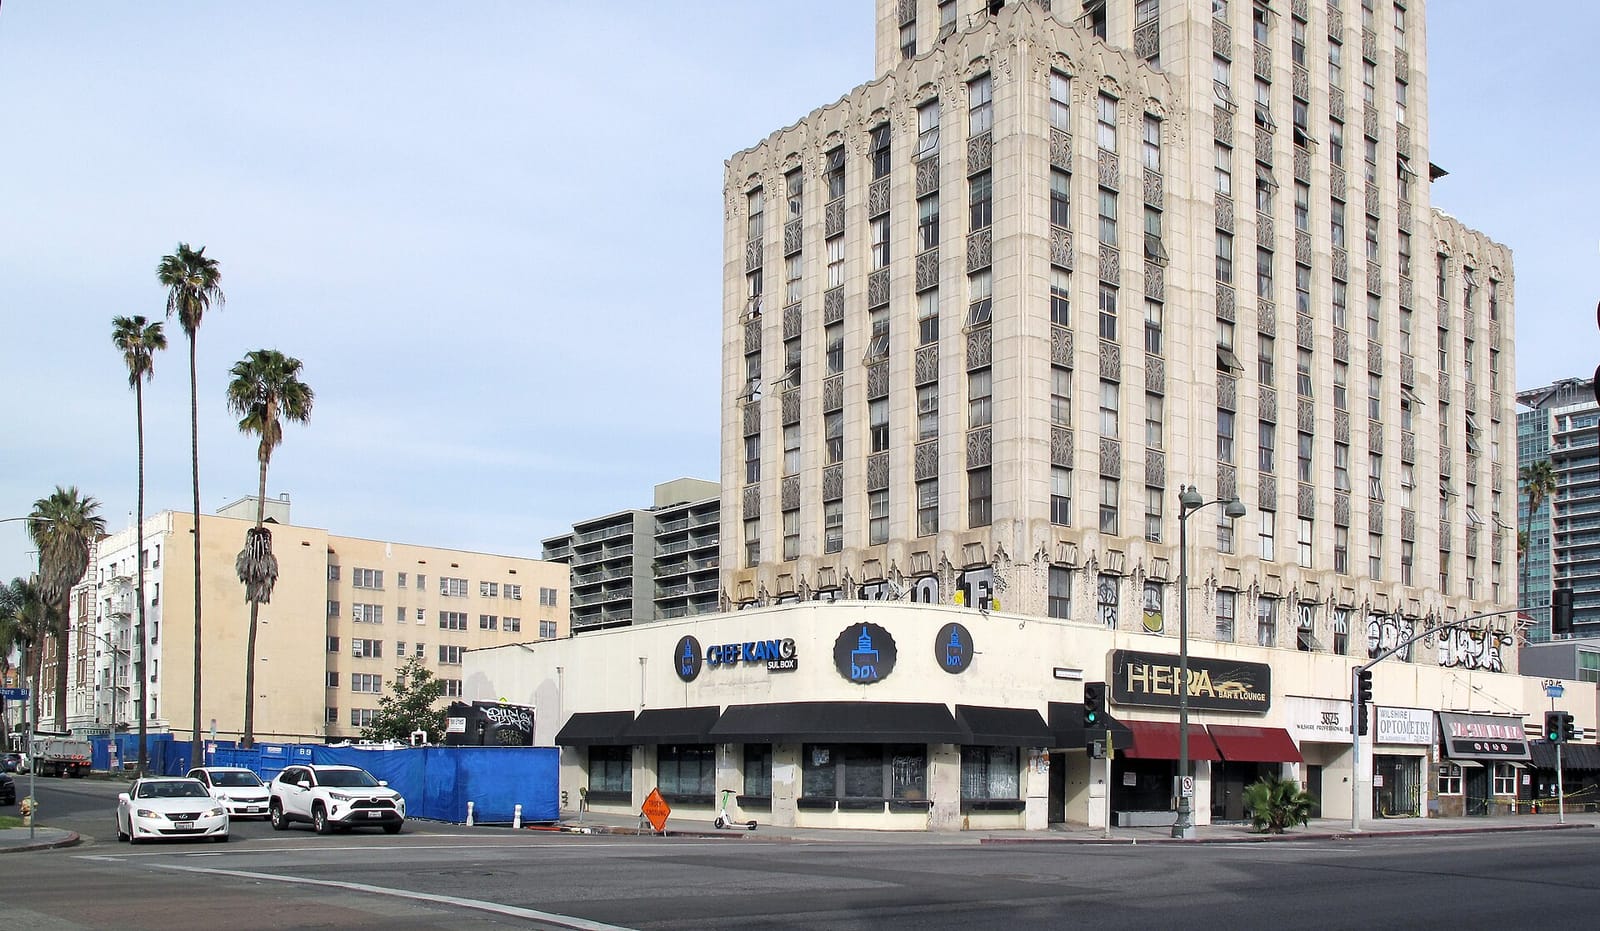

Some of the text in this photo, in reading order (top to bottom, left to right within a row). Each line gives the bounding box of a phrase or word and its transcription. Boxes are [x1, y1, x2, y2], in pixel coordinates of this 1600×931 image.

[706, 637, 796, 666] CHEF KANG
[767, 659, 794, 669] SUL BOX
[851, 662, 878, 680] box
[1126, 662, 1217, 698] HERA
[1218, 690, 1233, 699] BAR
[1239, 692, 1266, 702] LOUNGE
[1380, 719, 1430, 735] OPTOMETRY
